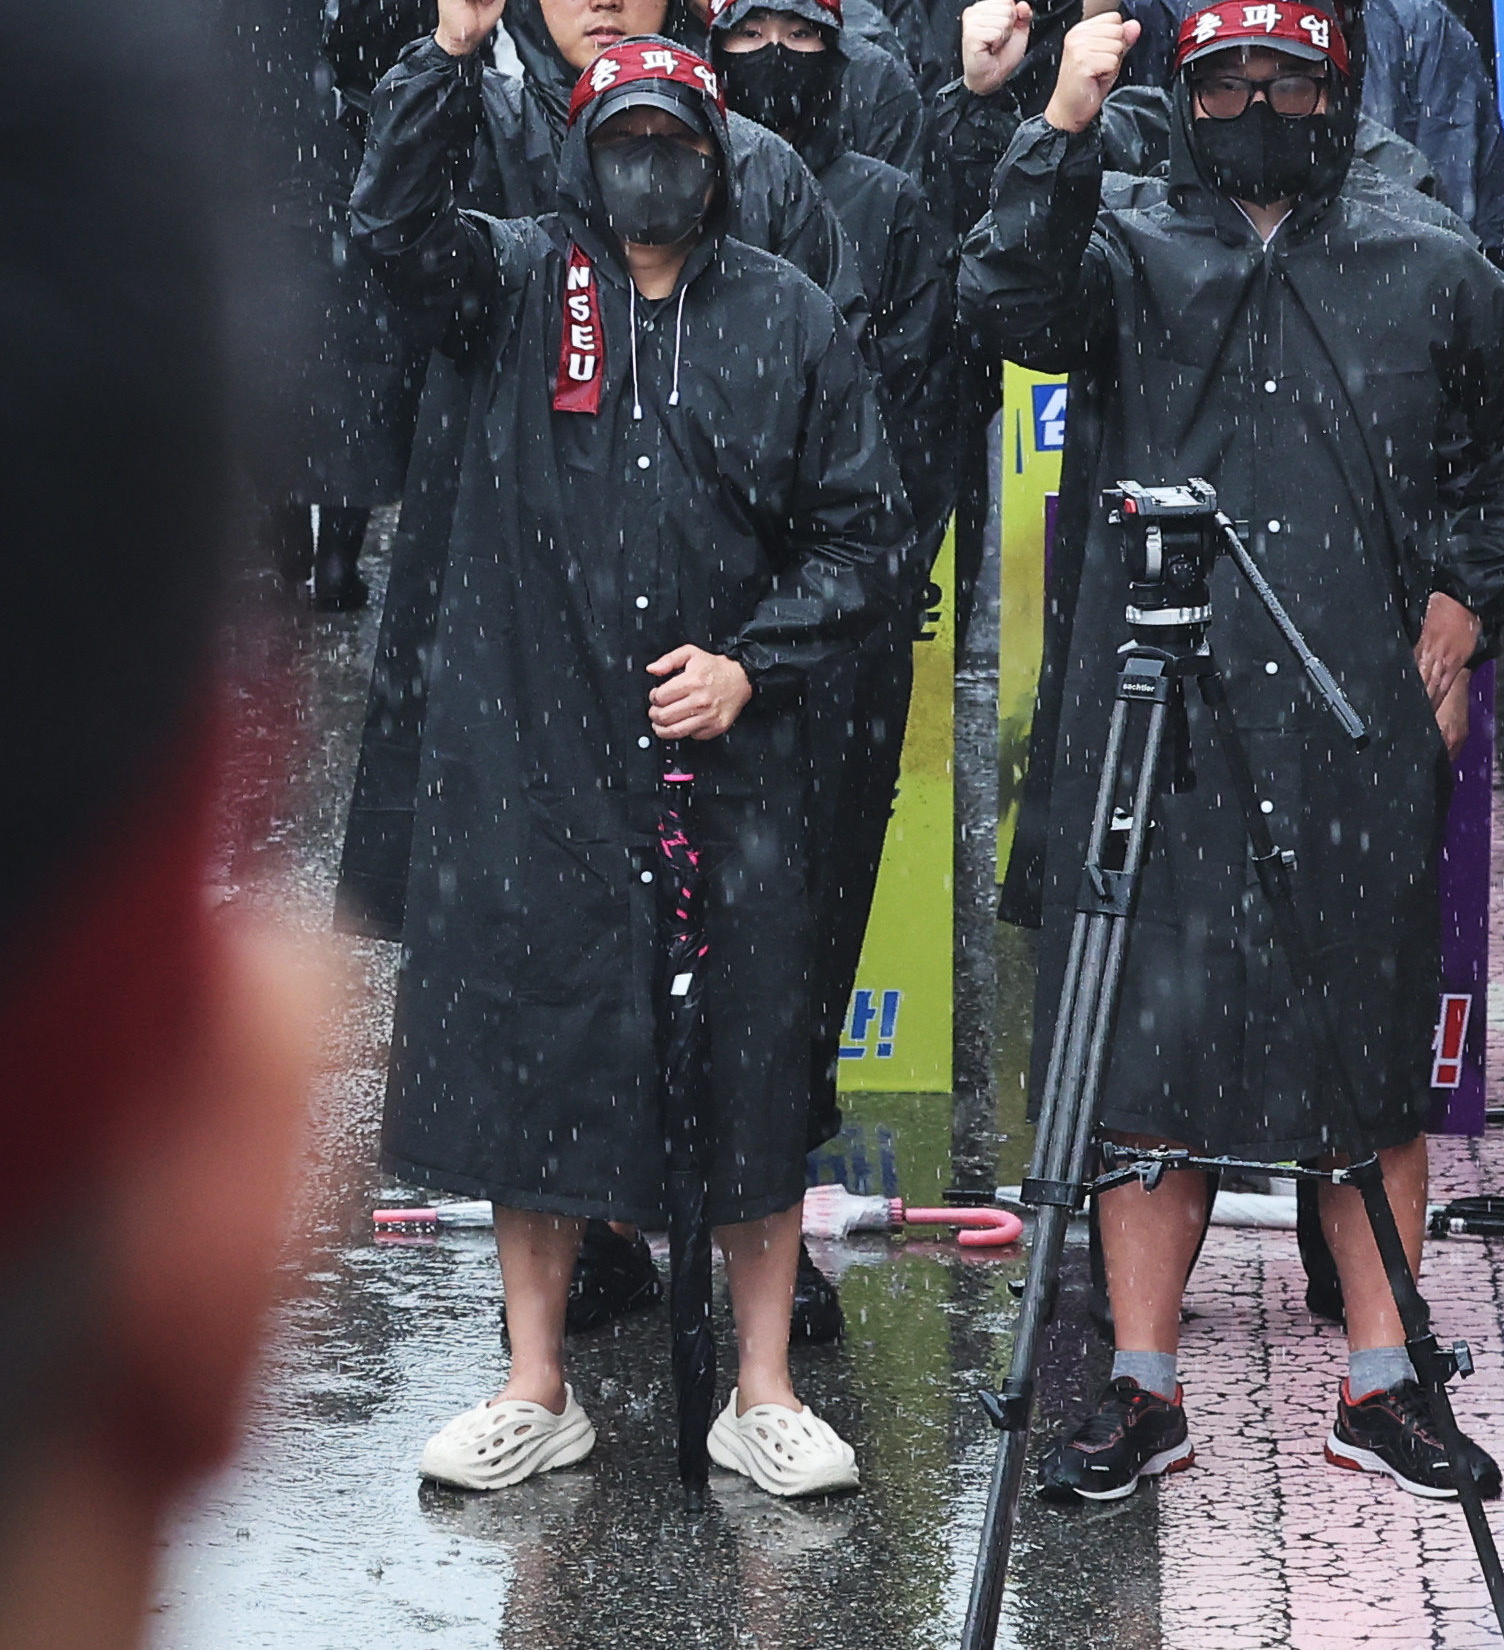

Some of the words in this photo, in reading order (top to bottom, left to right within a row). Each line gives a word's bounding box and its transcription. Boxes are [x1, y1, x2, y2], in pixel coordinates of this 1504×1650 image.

[1192, 4, 1329, 48] 총파업
[590, 50, 718, 99] 총파업
[567, 265, 595, 381] NSEU
